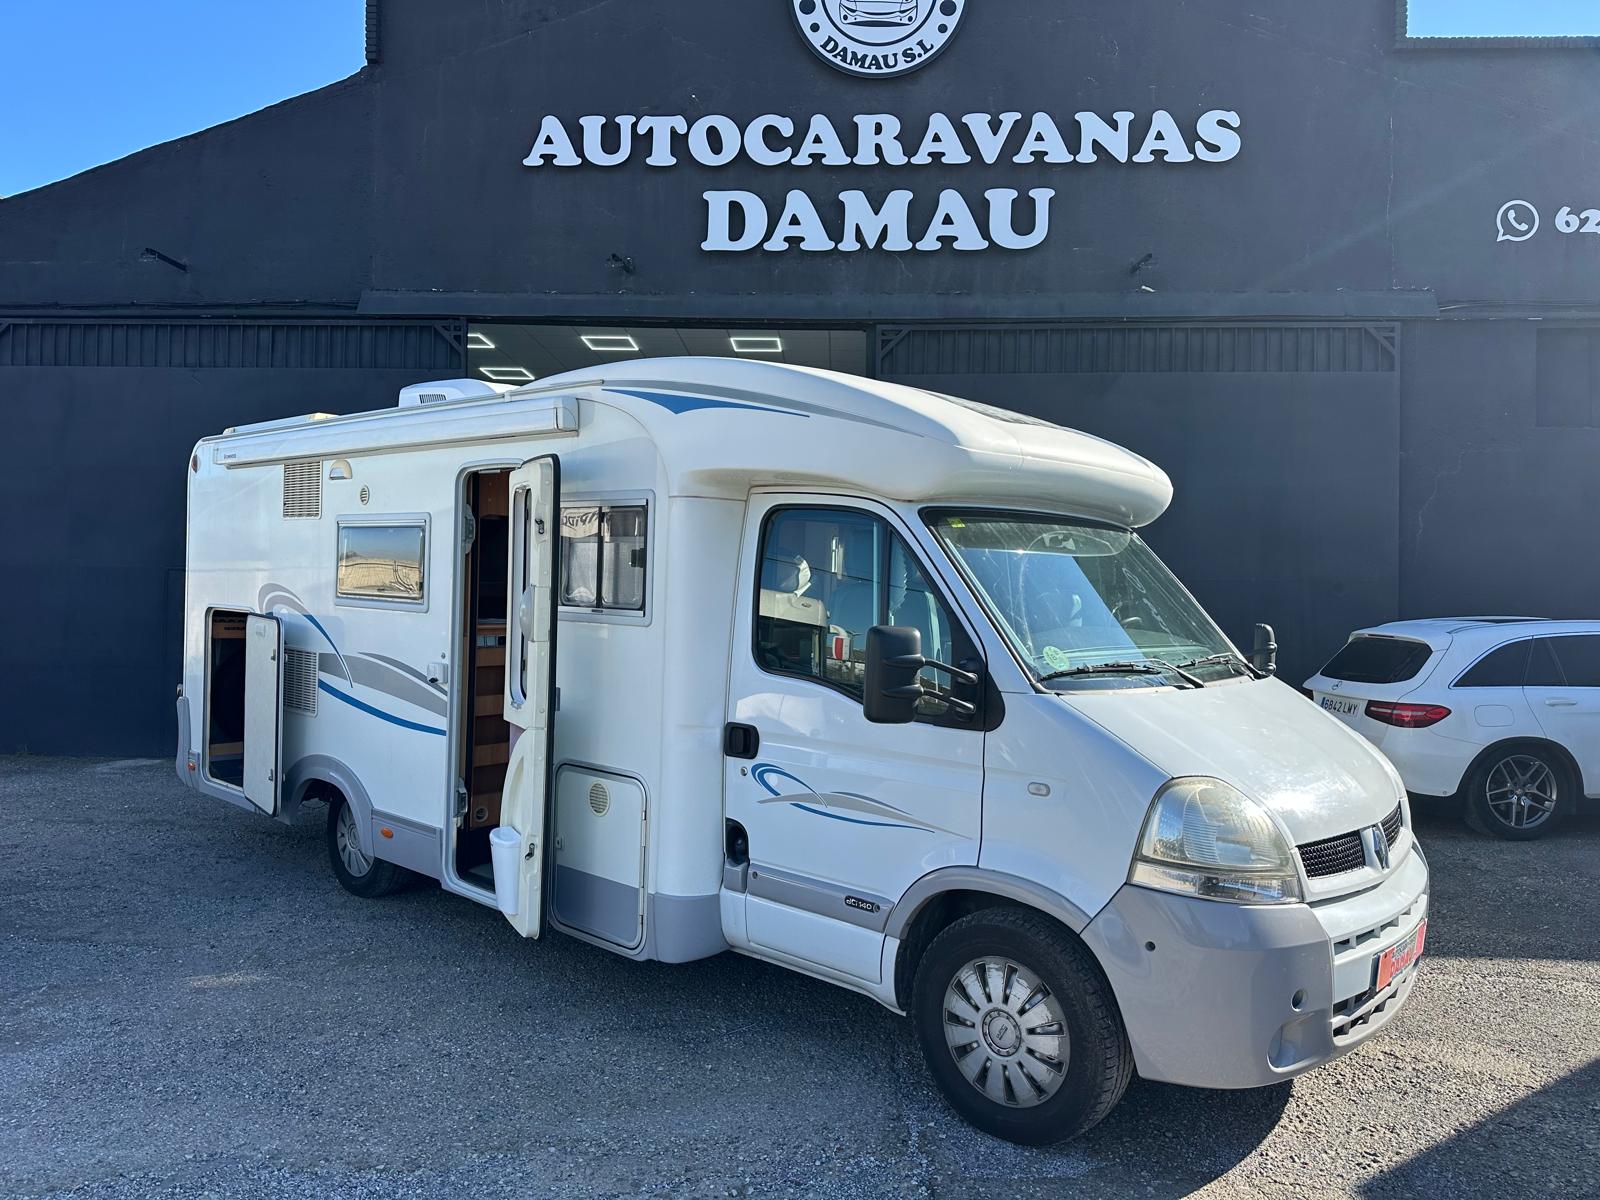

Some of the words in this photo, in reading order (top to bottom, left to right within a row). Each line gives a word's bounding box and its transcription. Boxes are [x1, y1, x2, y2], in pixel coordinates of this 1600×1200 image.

[820, 35, 898, 70] DAMAU
[901, 39, 935, 64] S.L
[522, 110, 1242, 167] AUTOCARAVANAS
[701, 187, 1055, 252] DAMAU
